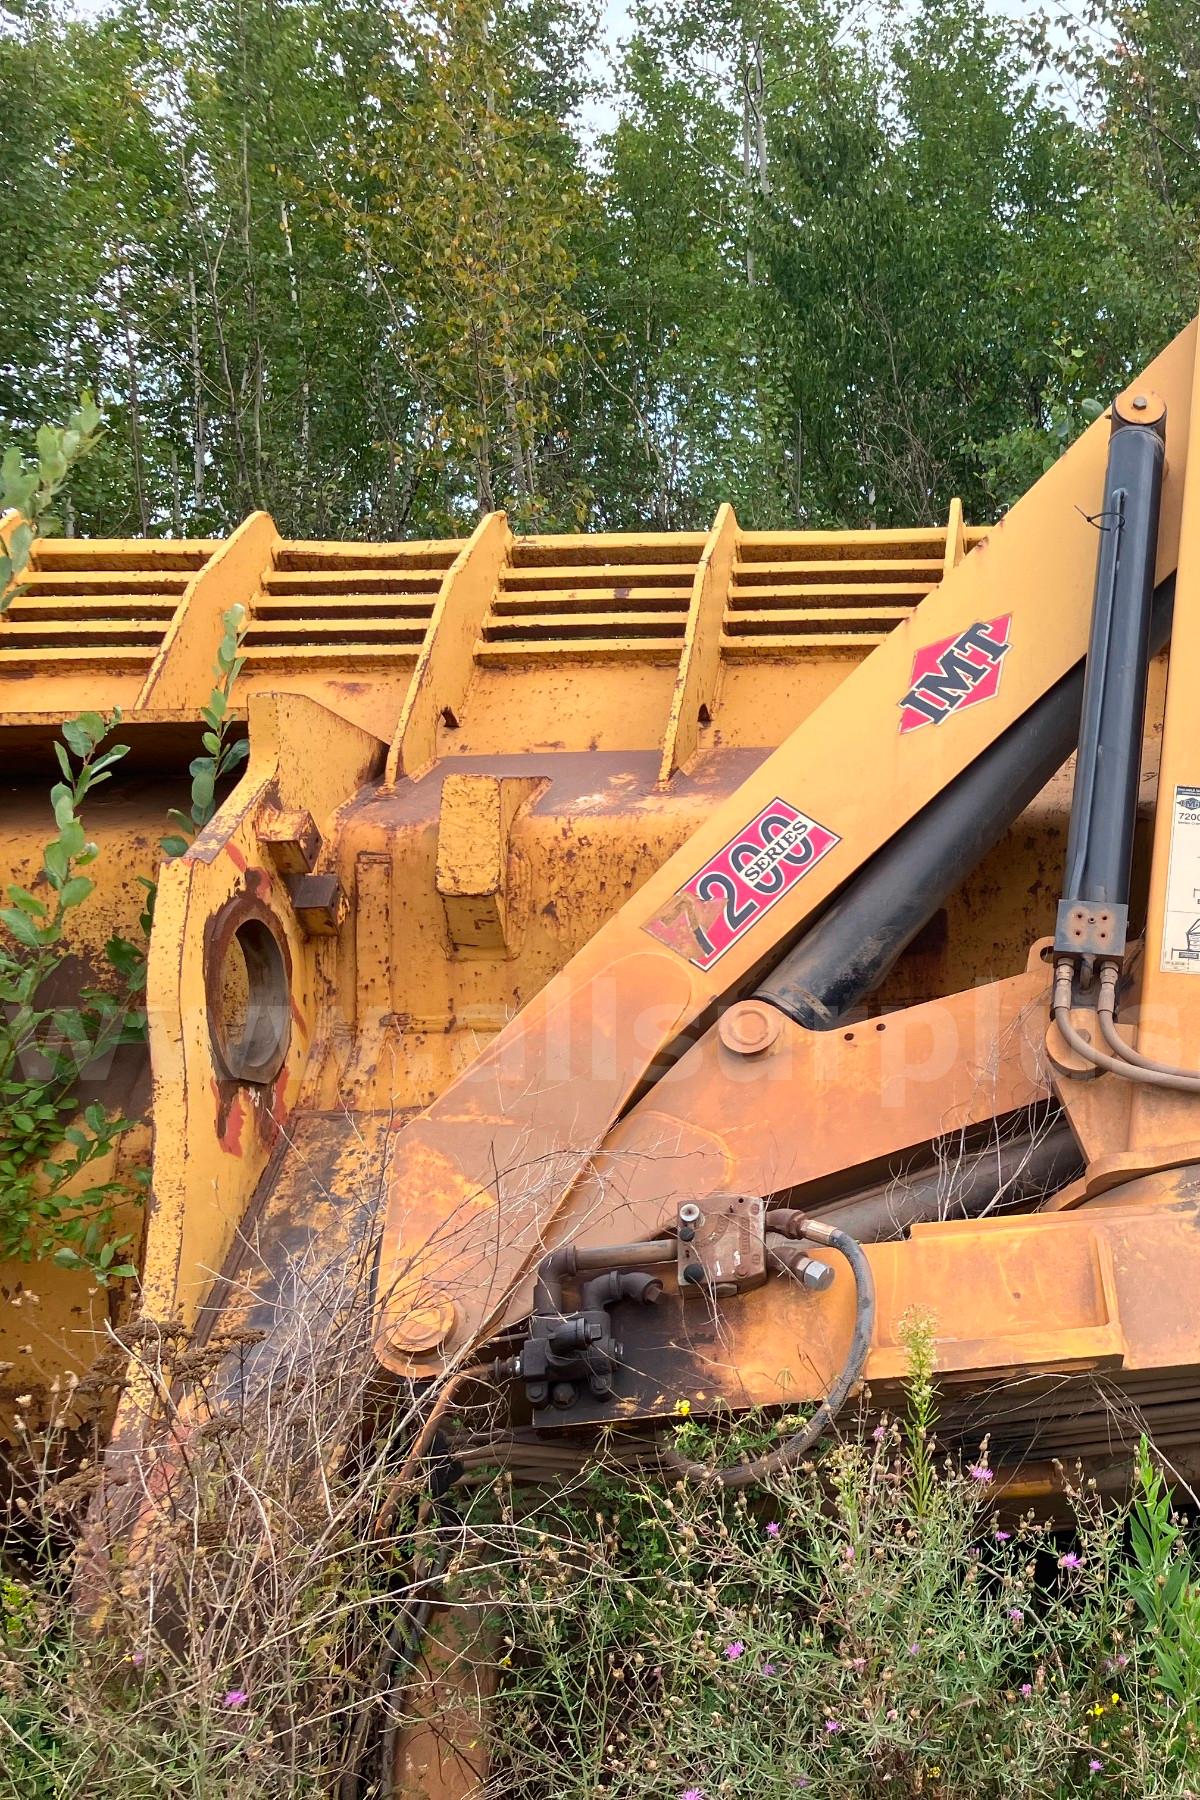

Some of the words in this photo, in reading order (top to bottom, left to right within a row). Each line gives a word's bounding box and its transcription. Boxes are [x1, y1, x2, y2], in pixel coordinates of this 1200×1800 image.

[900, 621, 1011, 725] IMT
[659, 814, 812, 955] 7200
[744, 820, 808, 882] SERIES
